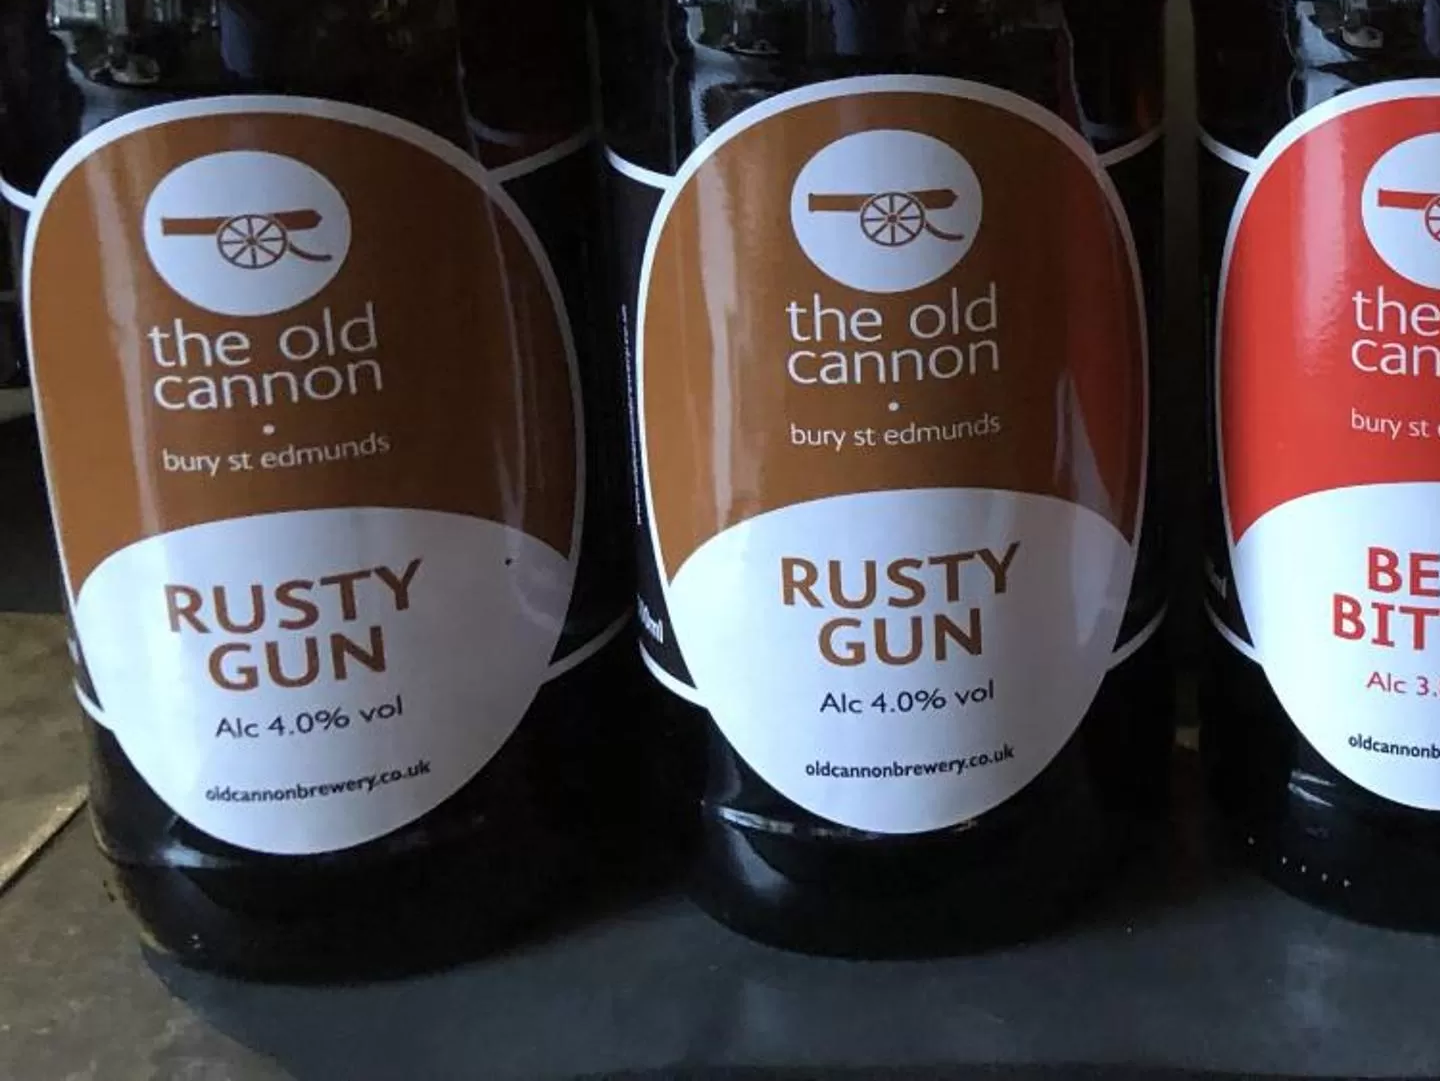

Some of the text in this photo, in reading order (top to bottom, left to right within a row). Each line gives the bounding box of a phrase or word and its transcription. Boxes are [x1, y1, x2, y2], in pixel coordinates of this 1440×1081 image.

[147, 301, 378, 369] the old
[785, 283, 998, 343] the old
[786, 338, 999, 384] cannon
[153, 360, 383, 410] cannon
[791, 413, 1001, 452] bury st edmunds
[1351, 408, 1402, 440] bury
[1407, 417, 1430, 438] st
[162, 432, 391, 476] bury st edmunds
[163, 558, 423, 635] RUSTY
[780, 541, 1021, 610] RUSTY
[208, 626, 388, 692] GUN
[818, 608, 984, 667] GUN
[820, 679, 995, 714] Alc 4.0% vol
[1366, 670, 1408, 695] Alc
[215, 695, 403, 739] Alc 4.0% vol
[205, 758, 431, 803] oldcannonbrewery.co.uk
[806, 744, 1015, 779] oldcannonbrewery.co.uk
